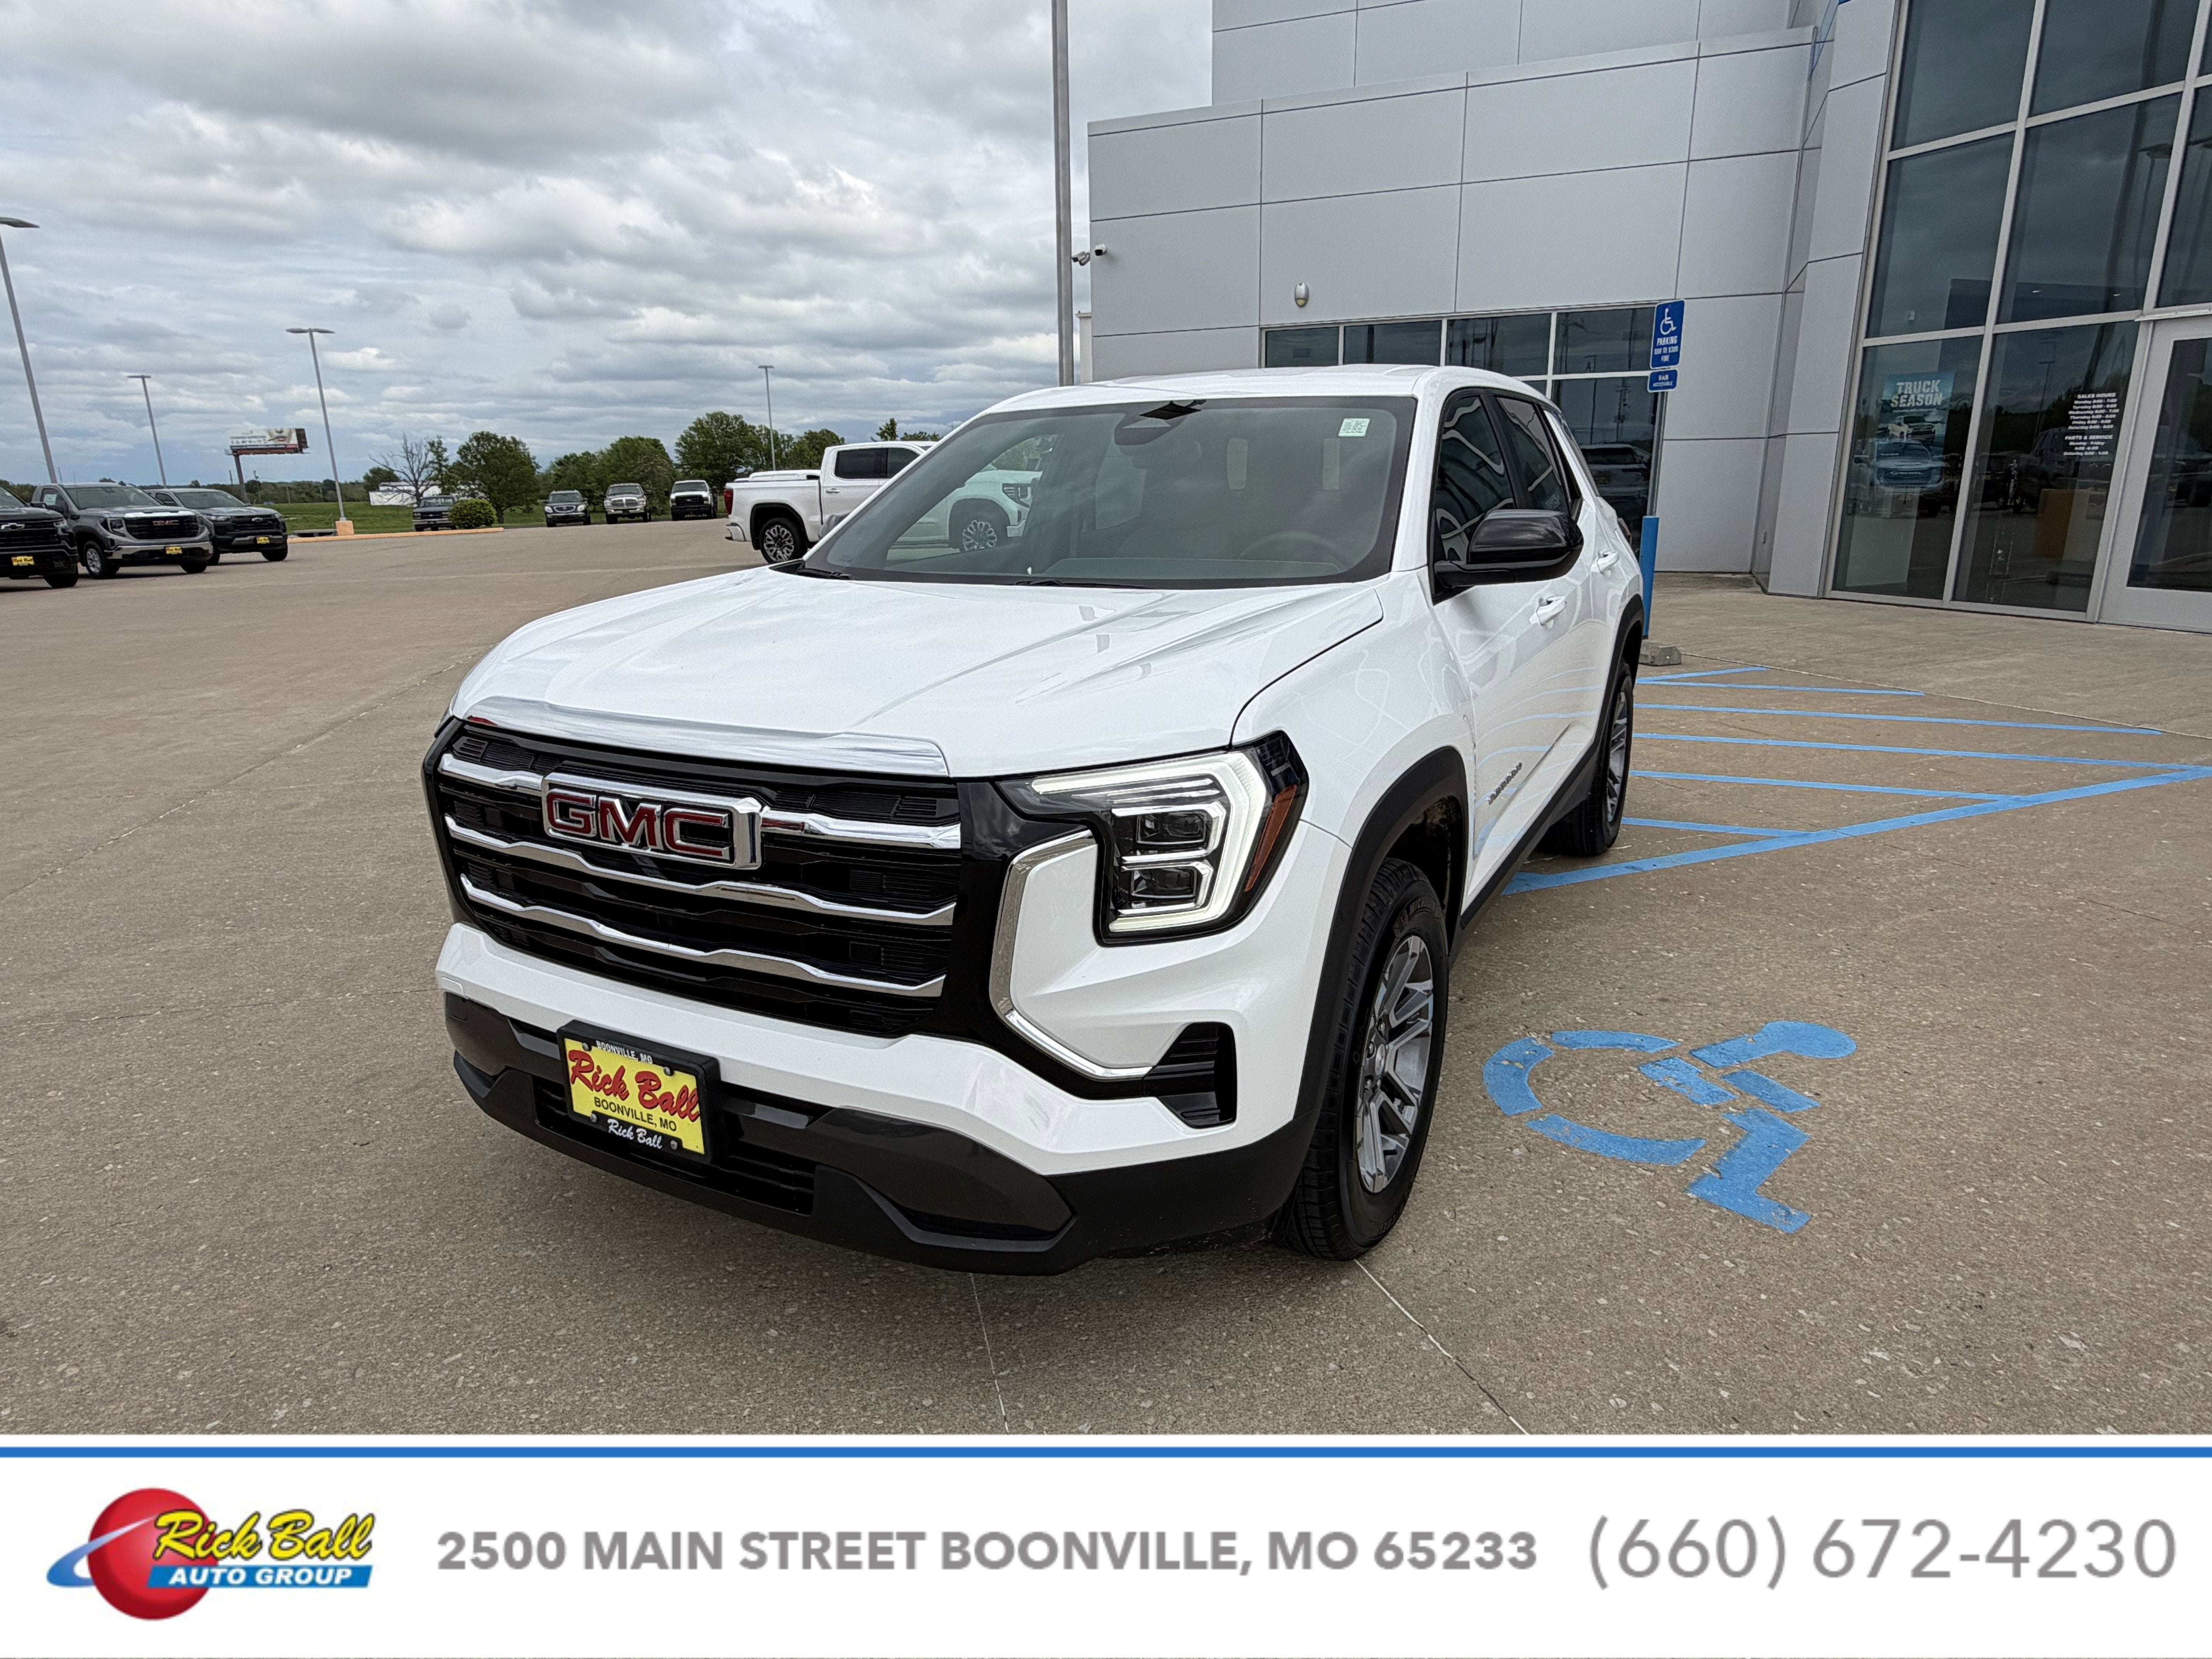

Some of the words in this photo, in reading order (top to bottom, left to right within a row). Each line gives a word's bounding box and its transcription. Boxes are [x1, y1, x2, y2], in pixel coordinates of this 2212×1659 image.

[1657, 335, 1677, 346] PARKING
[1891, 392, 1942, 407] SEASON
[1897, 380, 1941, 394] TRUCK
[546, 788, 731, 861] GMC
[596, 1040, 638, 1061] BOONVILLE,
[640, 1053, 653, 1064] MO
[568, 1050, 630, 1101] Rick
[634, 1070, 700, 1122] Ball
[594, 1096, 657, 1127] BOONVILLE,
[659, 1117, 677, 1132] MO
[607, 1118, 635, 1140] Rick
[636, 1127, 663, 1149] Ball
